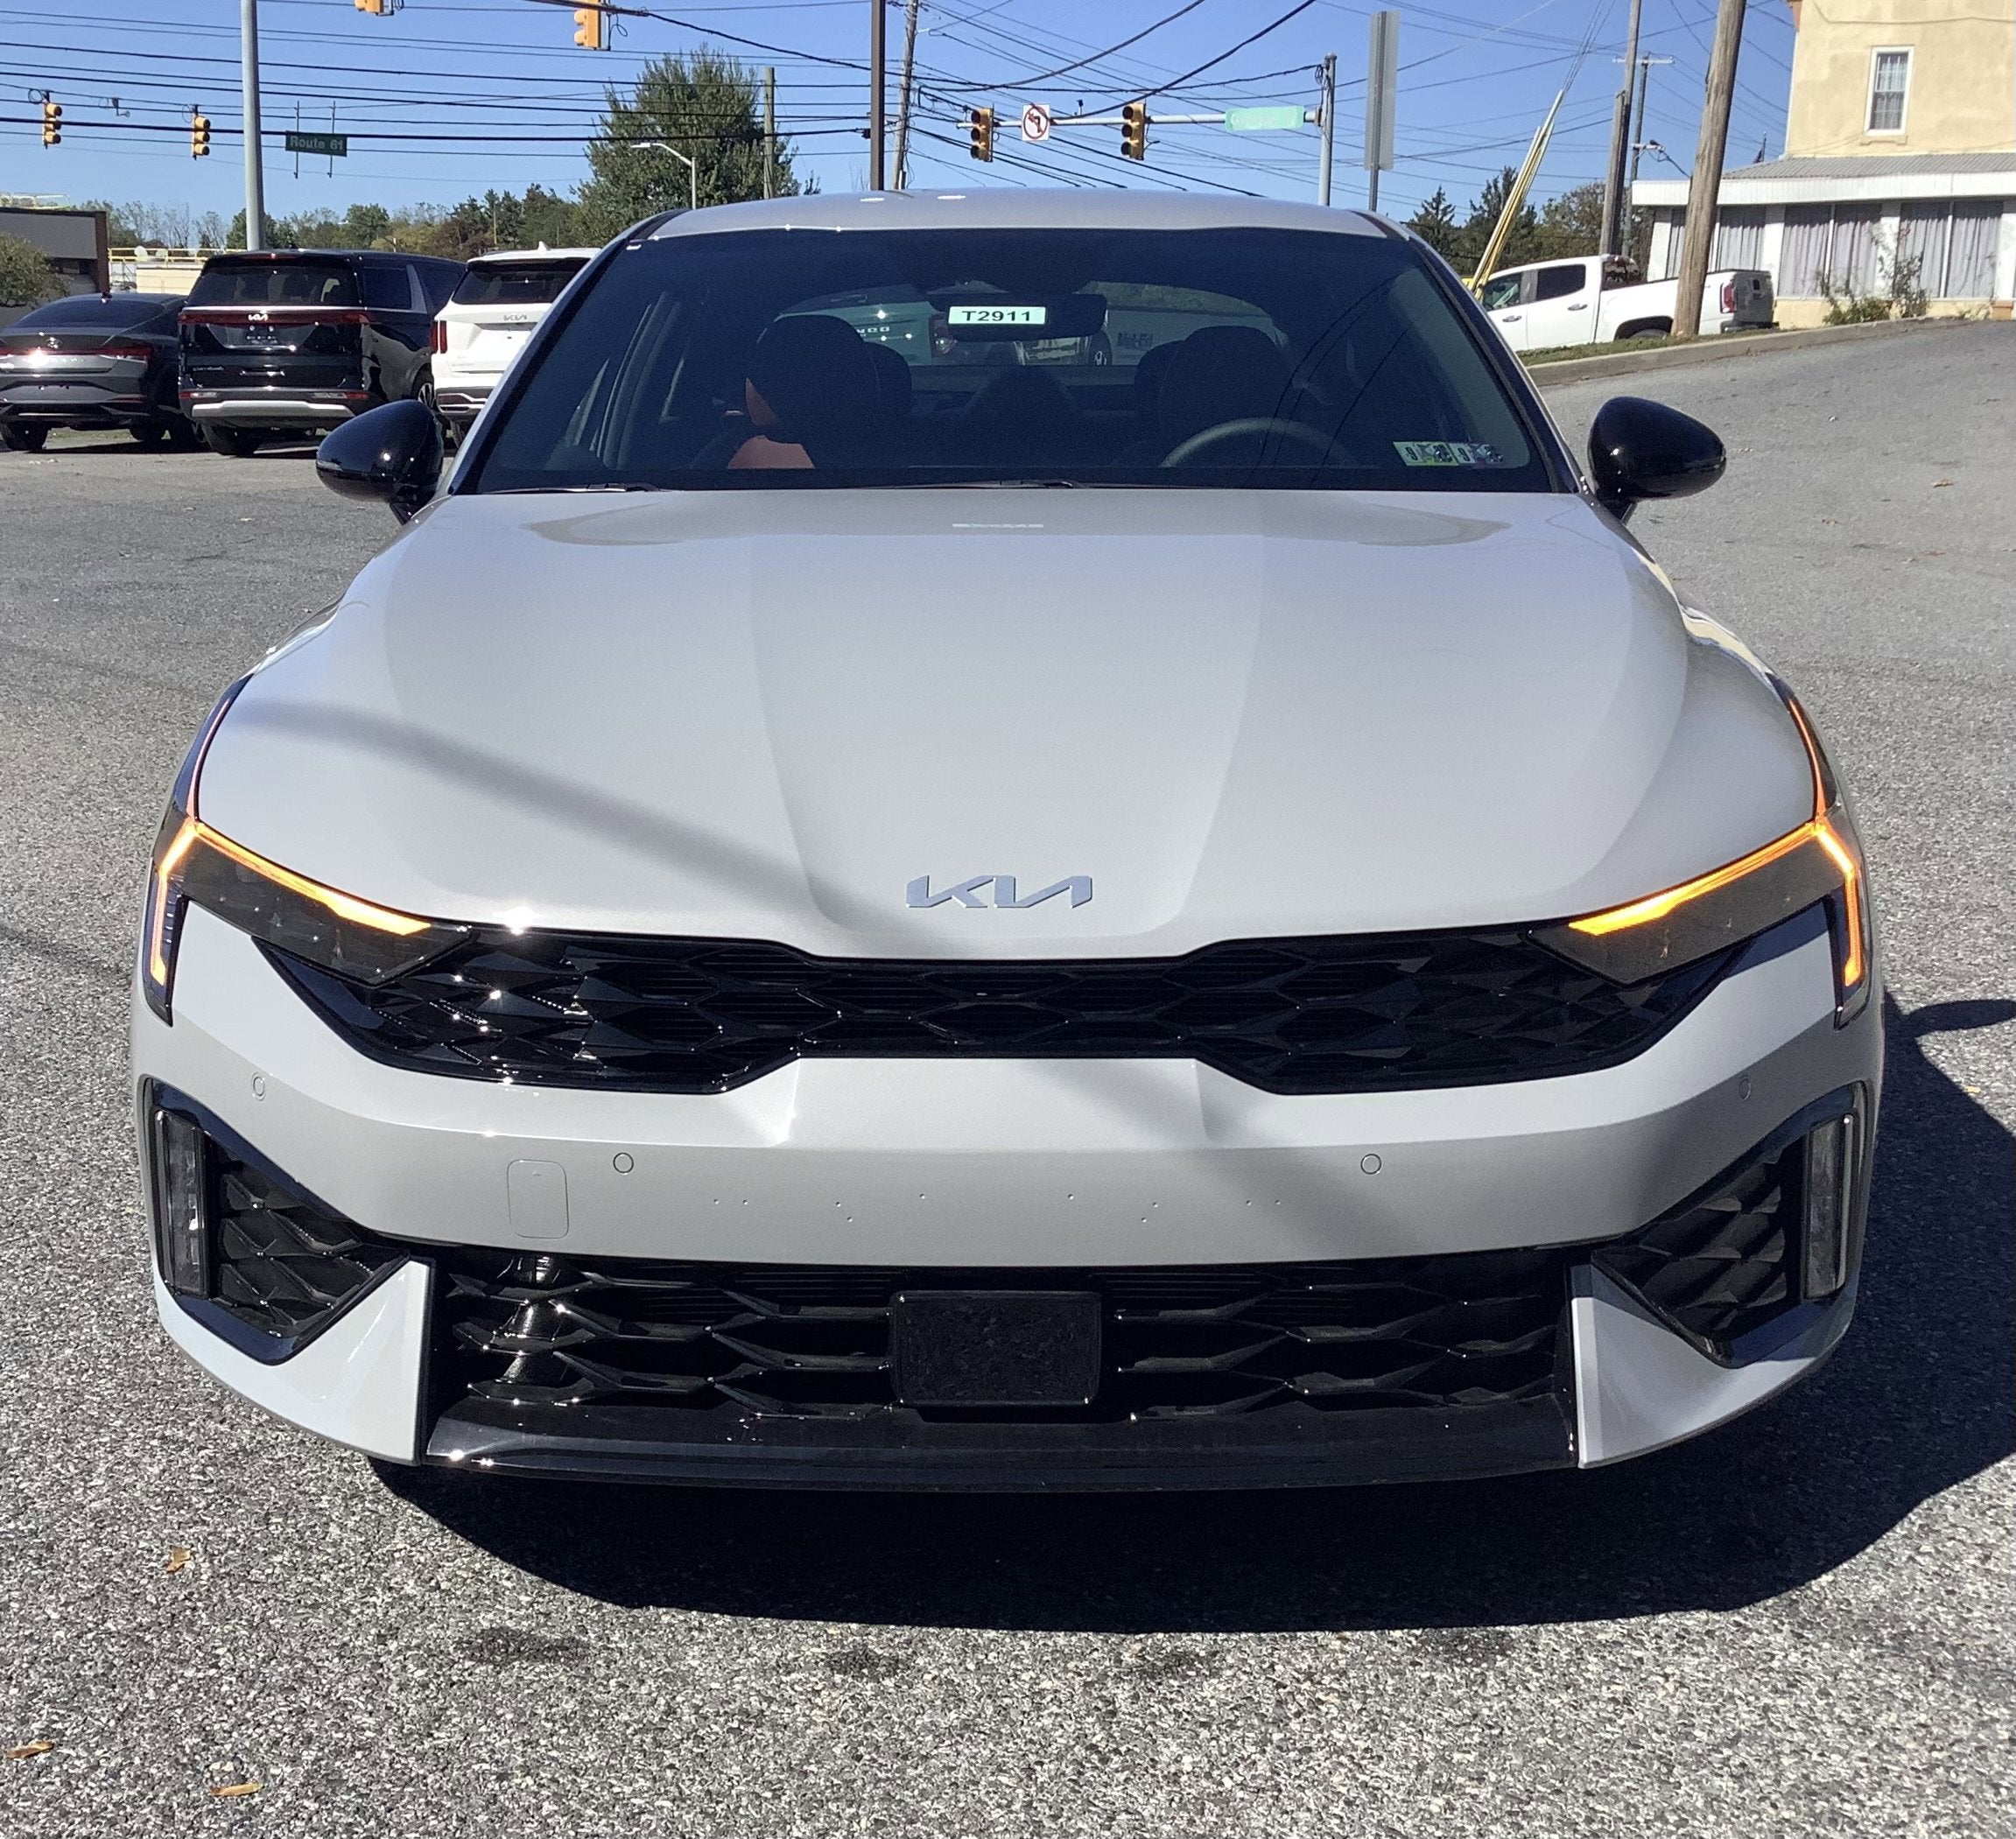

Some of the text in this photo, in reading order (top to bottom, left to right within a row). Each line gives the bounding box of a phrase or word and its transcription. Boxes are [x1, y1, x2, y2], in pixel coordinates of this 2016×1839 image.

[290, 135, 344, 151] Route 61
[961, 310, 1031, 322] T2911
[906, 874, 1092, 909] KIA
